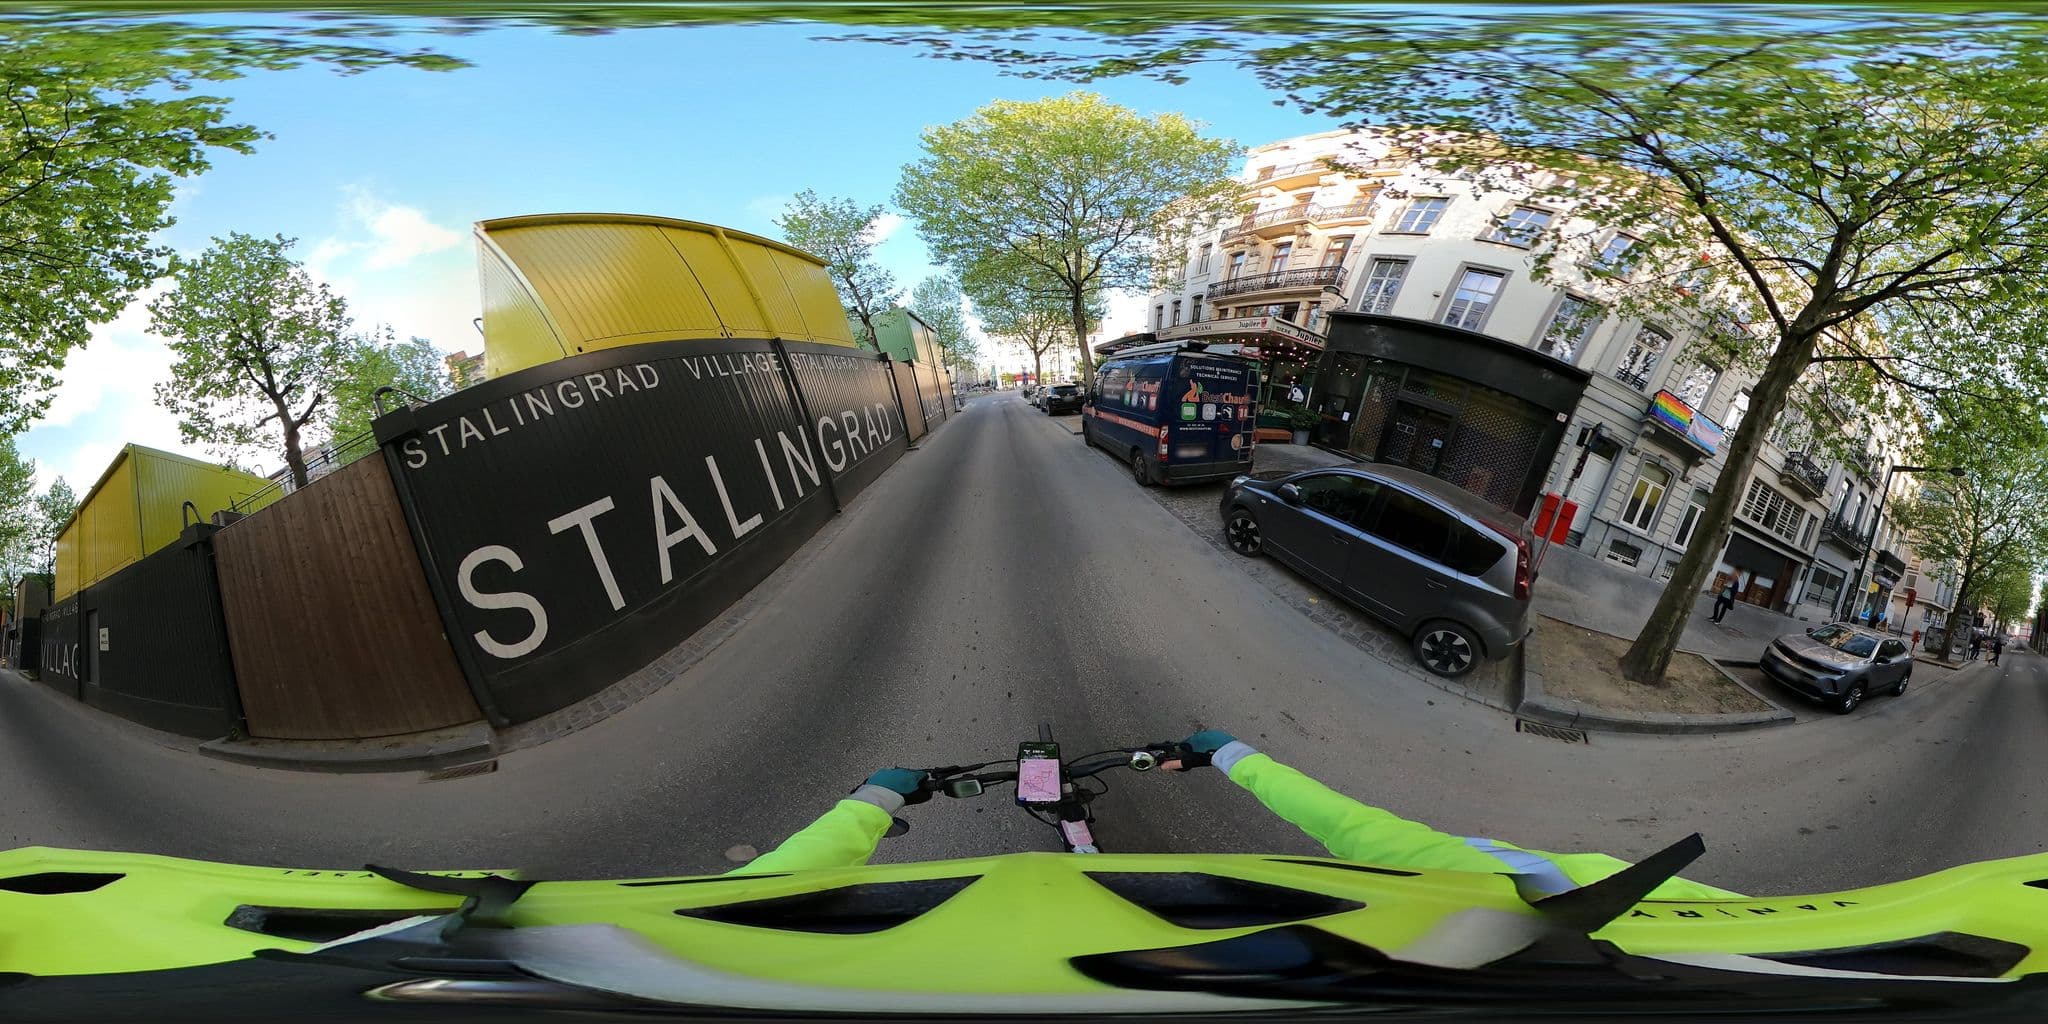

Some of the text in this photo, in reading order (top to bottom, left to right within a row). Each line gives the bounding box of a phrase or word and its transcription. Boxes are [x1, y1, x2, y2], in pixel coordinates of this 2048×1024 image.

[790, 352, 859, 370] STALINGRAD
[1296, 329, 1322, 344] Jupiler
[401, 352, 782, 470] STALINGRAD VILLAGE
[457, 402, 892, 660] STALINGRAD
